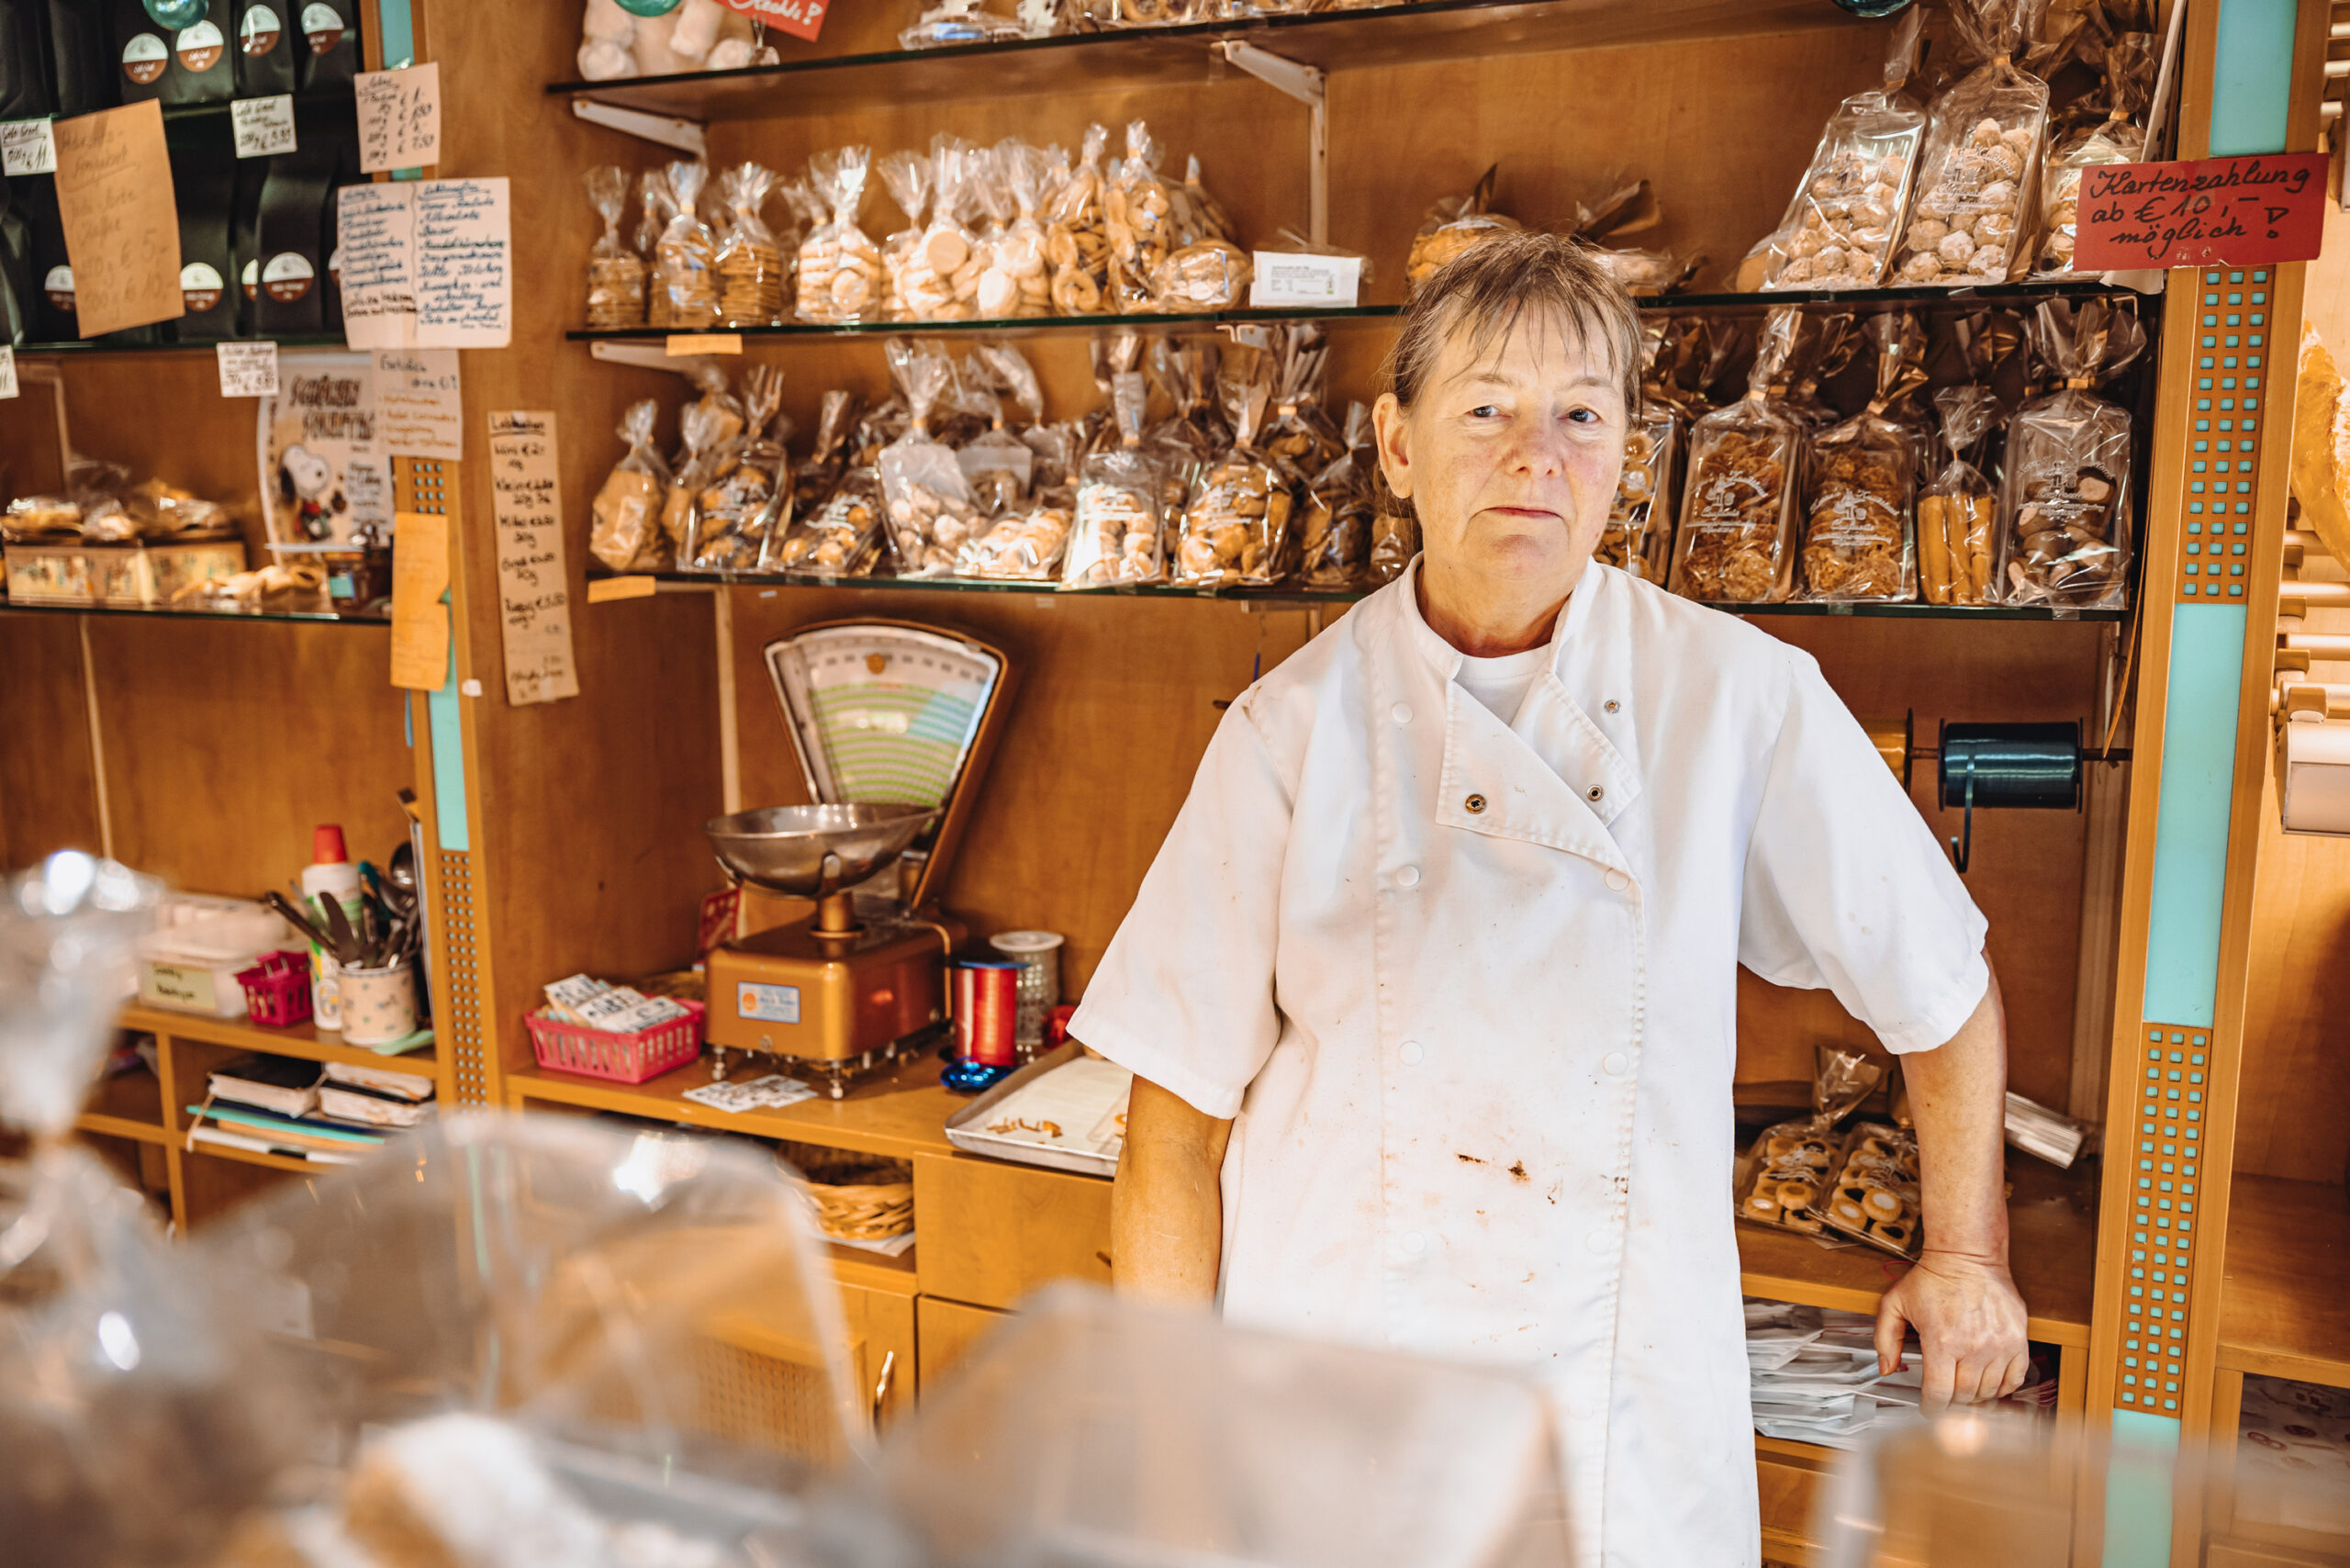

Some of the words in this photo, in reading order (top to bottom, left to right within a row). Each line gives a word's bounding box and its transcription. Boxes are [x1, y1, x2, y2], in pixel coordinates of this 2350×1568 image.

[2089, 160, 2311, 199] Kartenzahlung
[2091, 201, 2124, 223] ab
[2109, 217, 2247, 259] möglich
